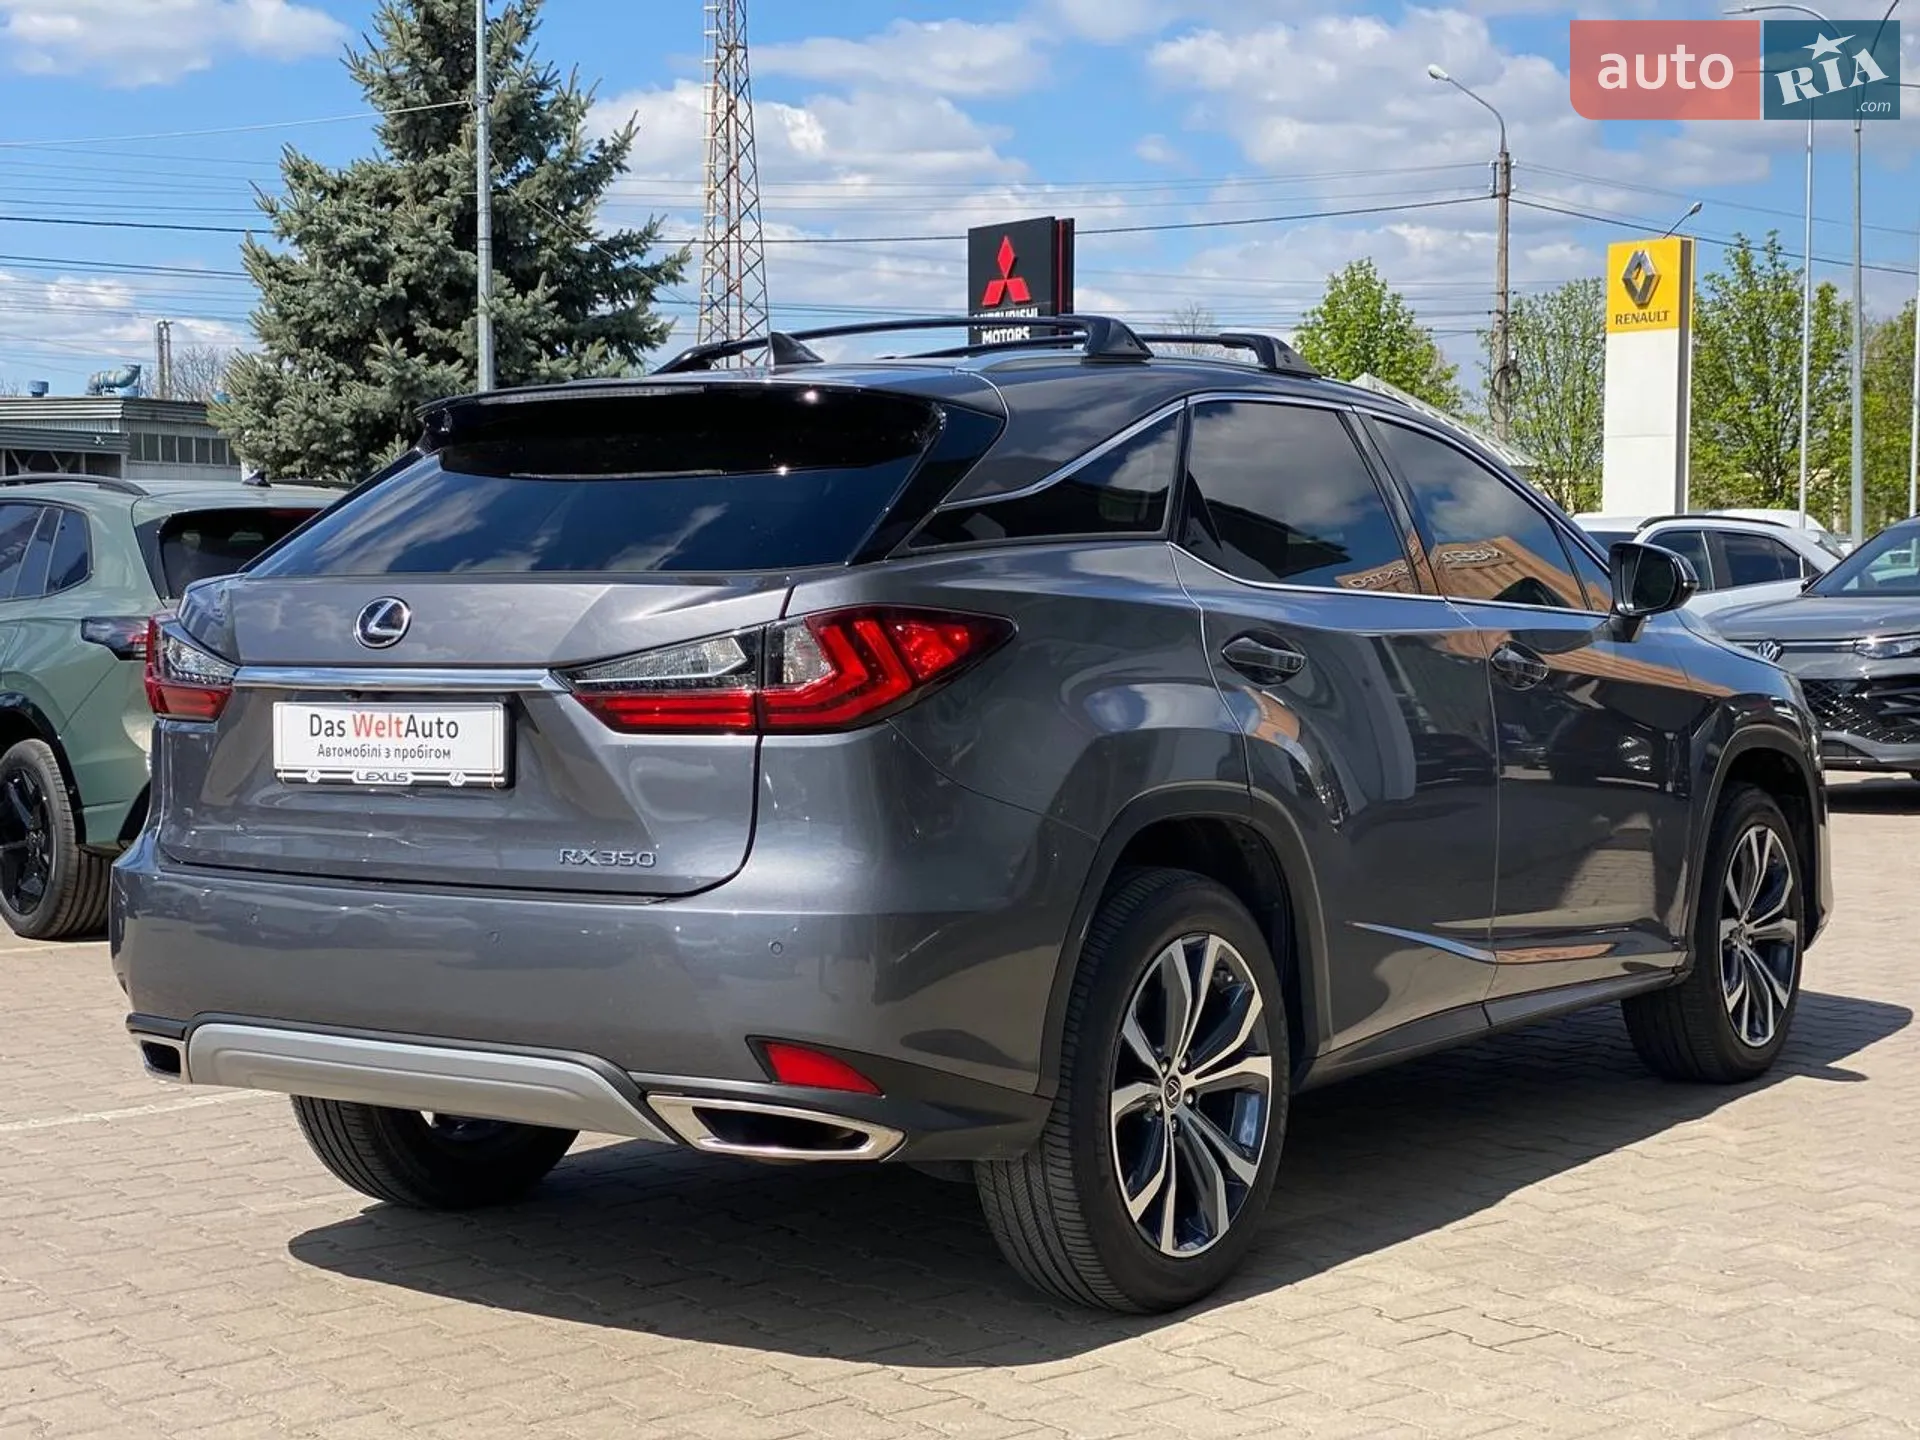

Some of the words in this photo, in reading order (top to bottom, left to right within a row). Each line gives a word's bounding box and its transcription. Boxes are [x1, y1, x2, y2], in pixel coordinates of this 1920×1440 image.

[1615, 310, 1670, 325] RENAULT
[982, 326, 1031, 345] MOTORS
[310, 713, 346, 738] Das
[352, 713, 459, 739] WeltAuto
[317, 744, 382, 759] Автомобілі
[384, 746, 391, 759] з
[394, 745, 451, 762] пробігом
[356, 771, 409, 782] LEXUS
